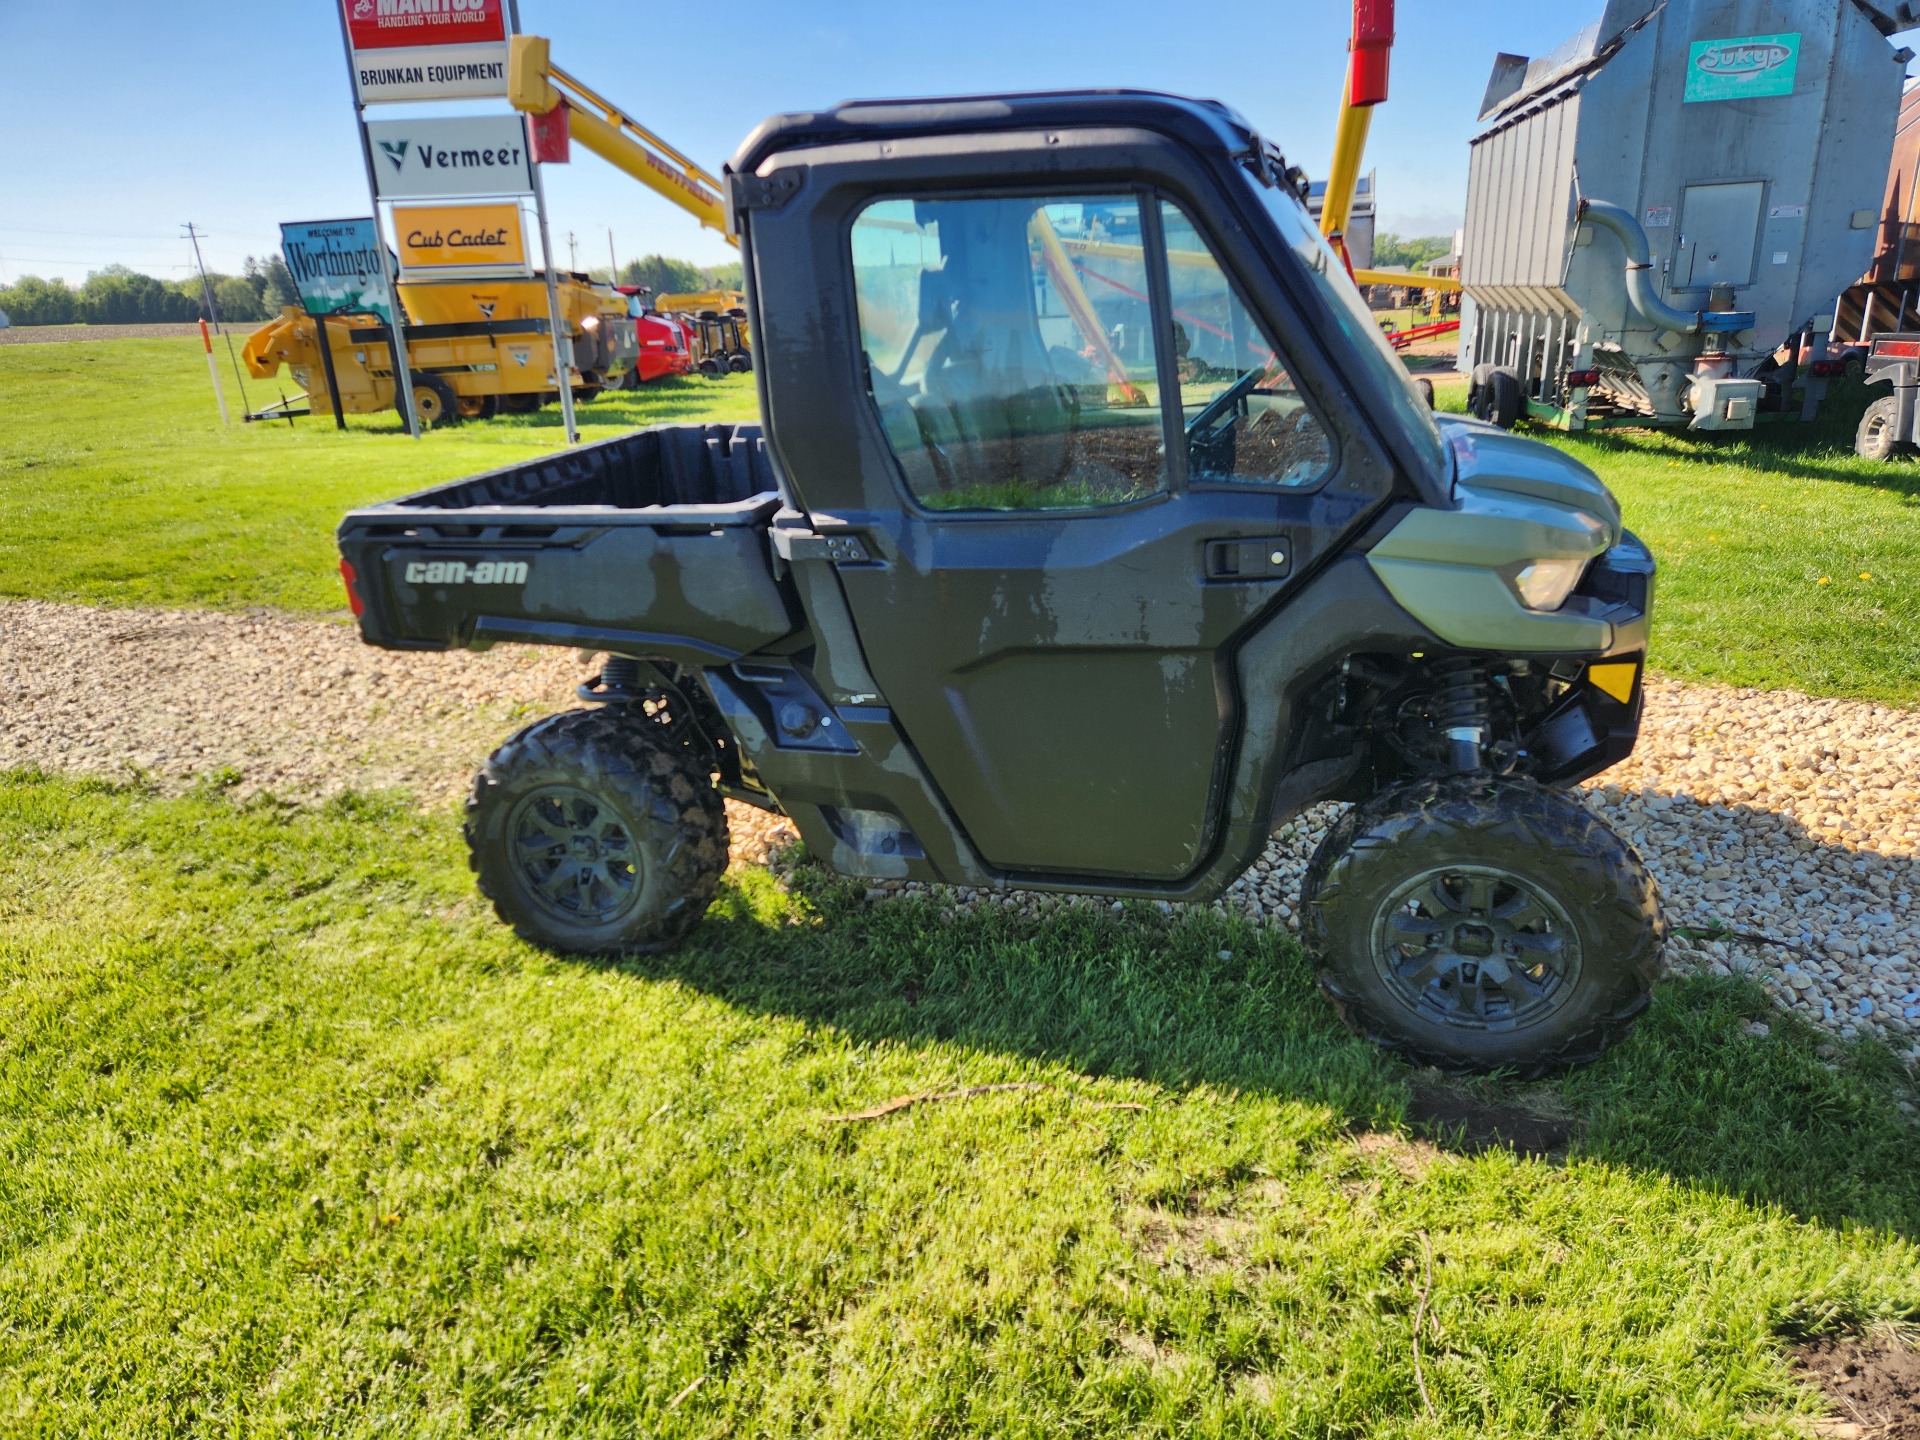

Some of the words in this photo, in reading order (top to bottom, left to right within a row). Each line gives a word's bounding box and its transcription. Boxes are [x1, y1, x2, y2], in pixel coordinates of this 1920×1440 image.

[378, 15, 424, 28] HANDLING
[426, 13, 450, 25] YOUR
[452, 11, 486, 23] WORLD
[360, 66, 424, 86] BRUNKAN
[427, 62, 503, 84] EQUIPMENT
[417, 144, 520, 169] Vermeer
[307, 228, 343, 238] WELCOME
[345, 226, 355, 236] TO
[407, 230, 443, 248] Cub
[447, 228, 507, 247] Cadet
[287, 235, 380, 286] Worthingto
[405, 560, 529, 584] can-am
